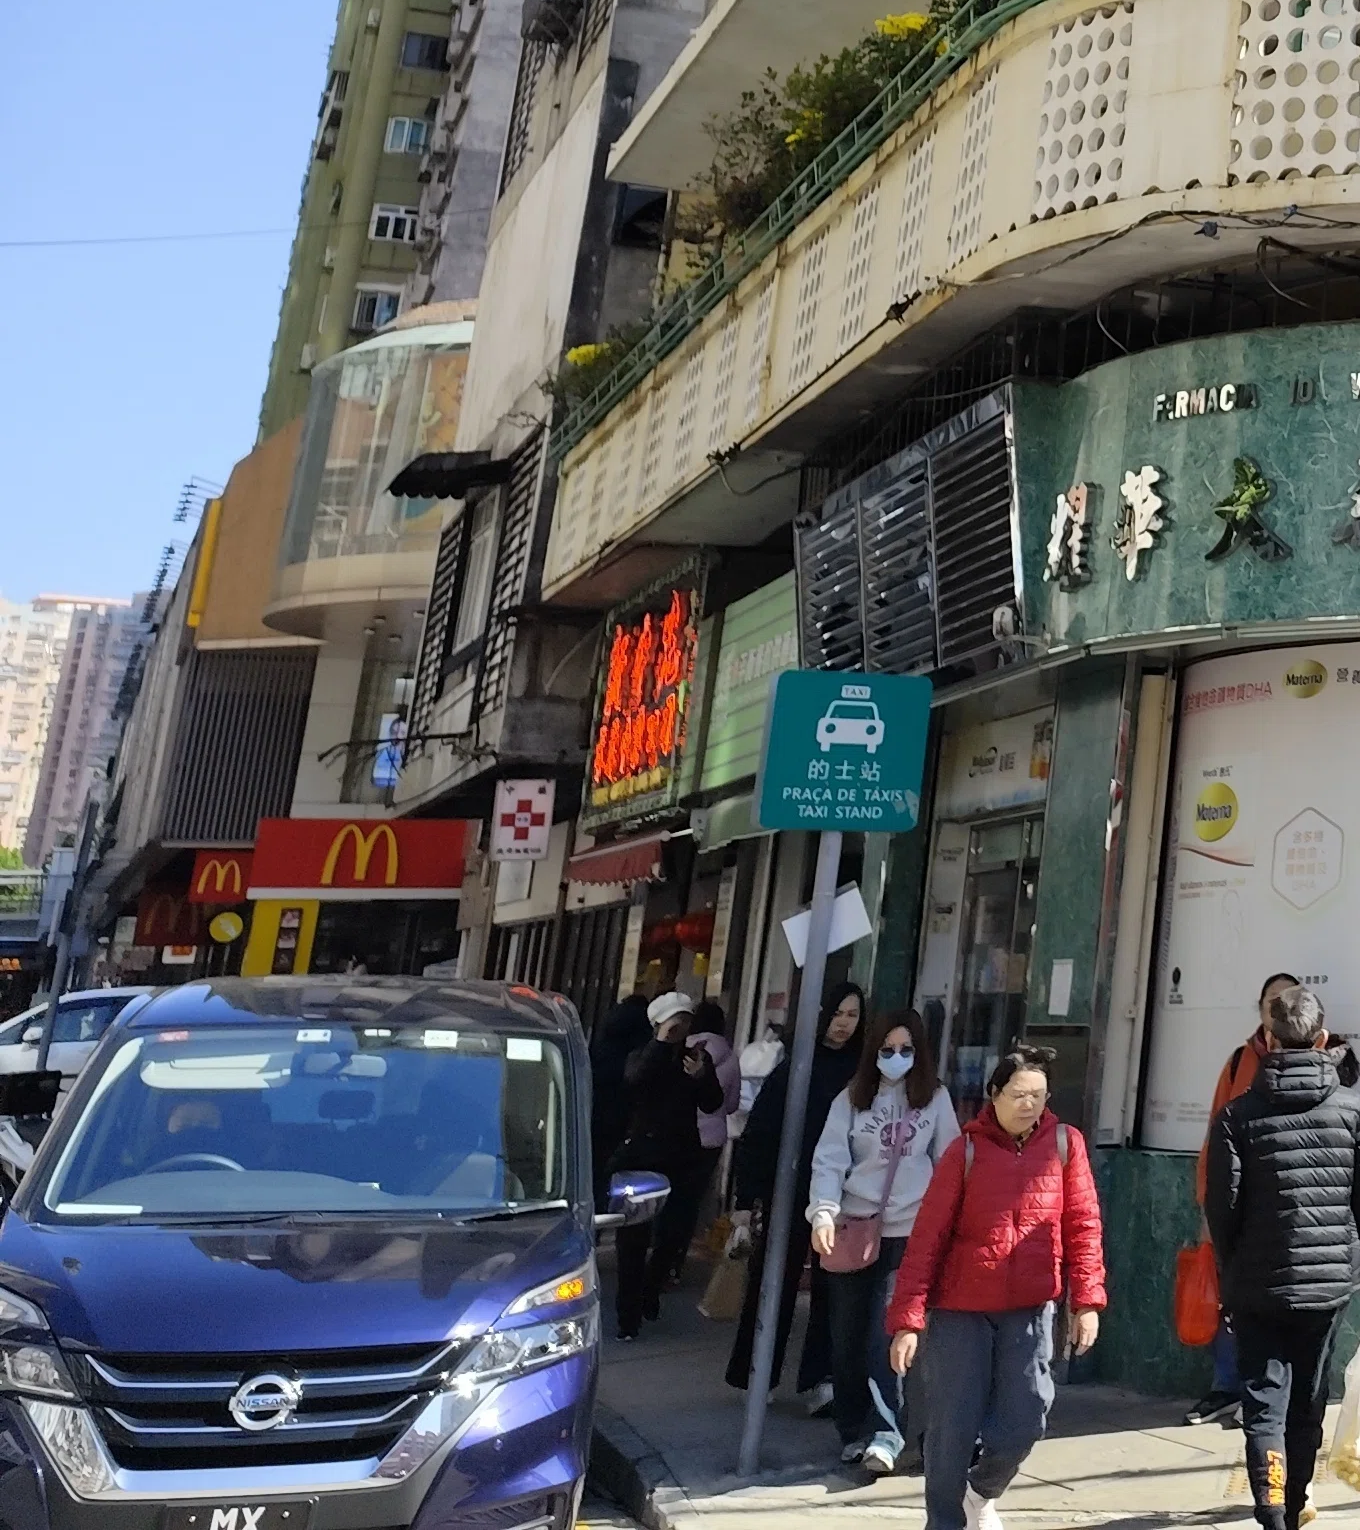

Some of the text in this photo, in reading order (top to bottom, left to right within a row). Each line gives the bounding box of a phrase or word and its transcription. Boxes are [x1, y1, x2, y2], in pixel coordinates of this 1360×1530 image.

[1286, 673, 1323, 687] Materna
[844, 686, 868, 697] TAXI
[808, 759, 882, 782] 的士站
[837, 789, 856, 802] DE
[798, 804, 883, 819] TAXI STAND
[236, 1397, 290, 1409] NISSAN
[209, 1505, 267, 1530] MX
